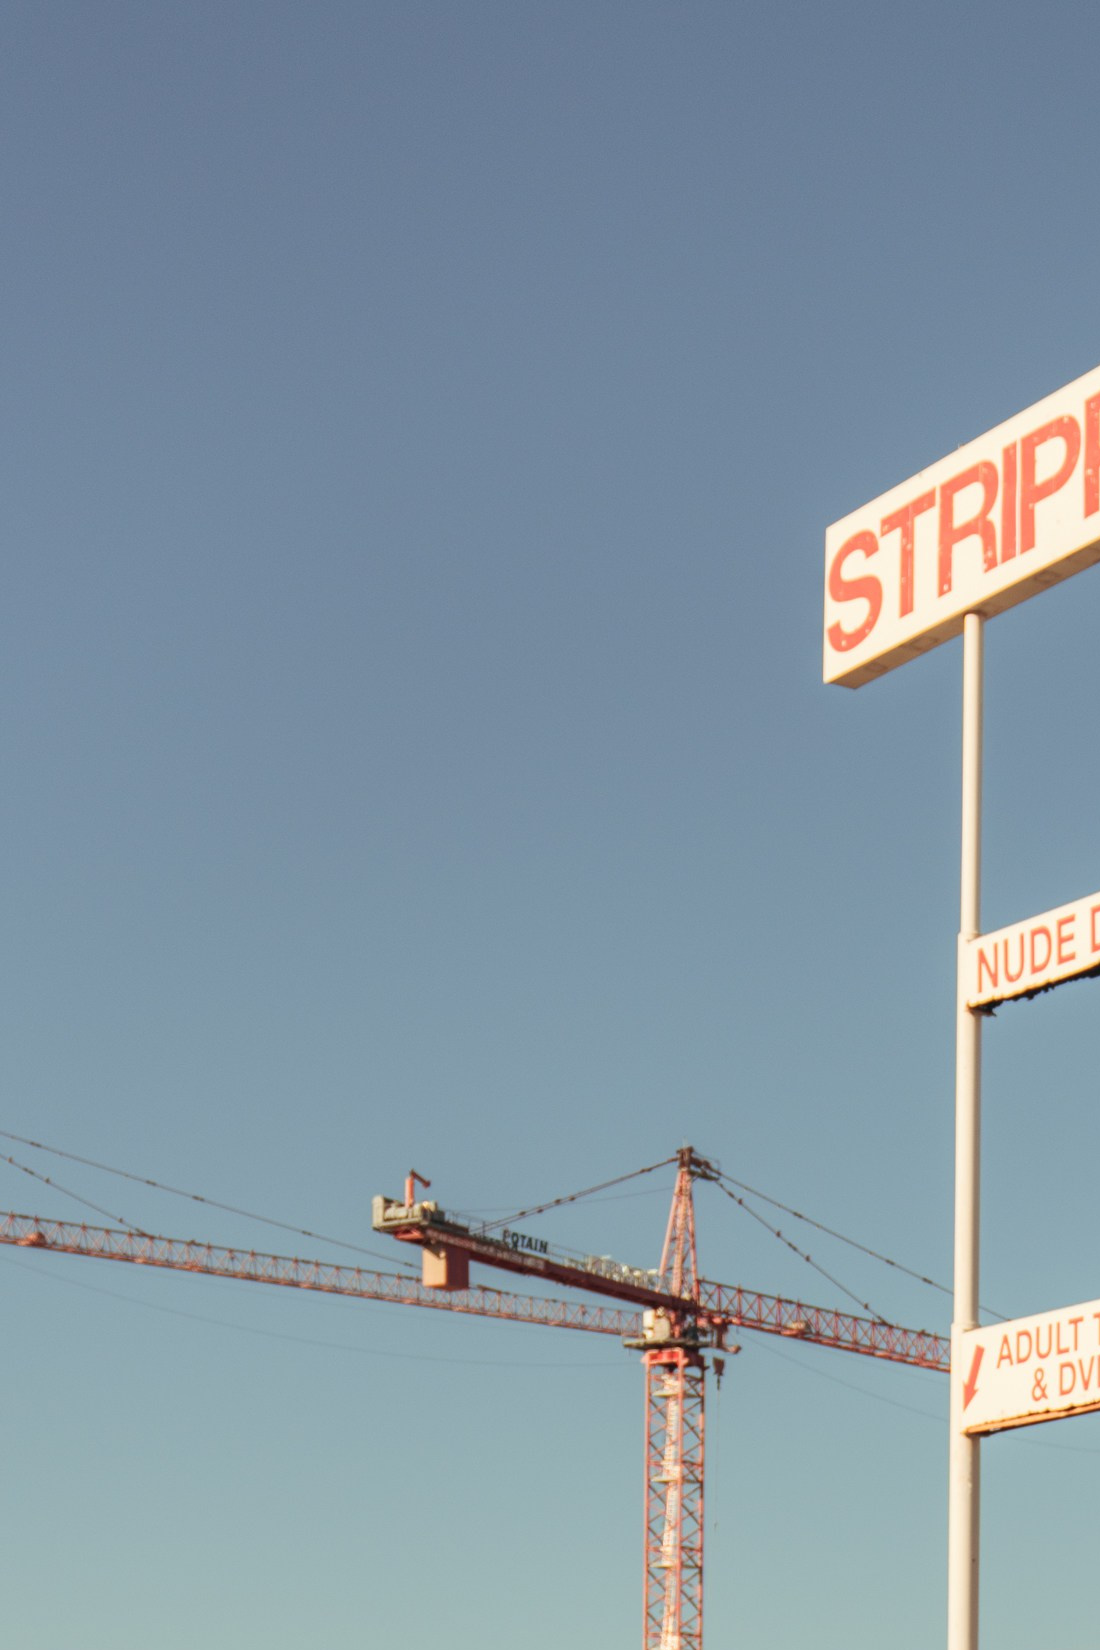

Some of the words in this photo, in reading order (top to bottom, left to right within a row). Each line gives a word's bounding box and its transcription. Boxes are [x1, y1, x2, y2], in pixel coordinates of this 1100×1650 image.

[977, 913, 1076, 994] NUDE
[996, 1317, 1084, 1369] ADULT
[1031, 1367, 1048, 1402] &
